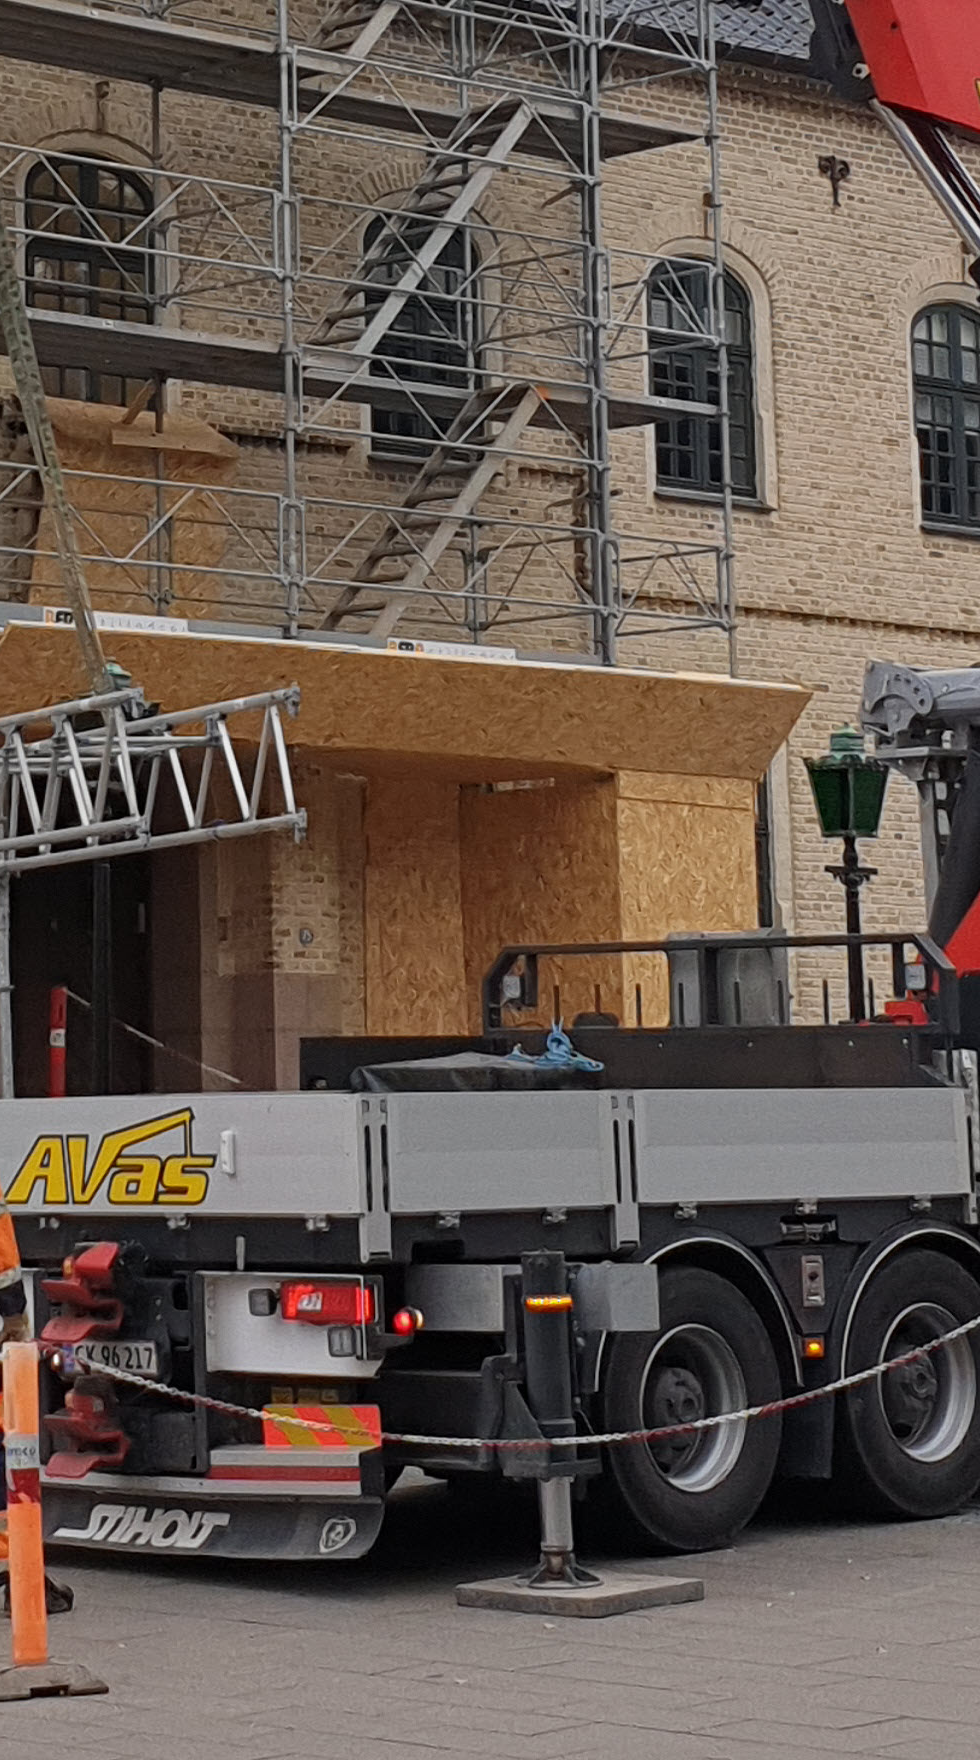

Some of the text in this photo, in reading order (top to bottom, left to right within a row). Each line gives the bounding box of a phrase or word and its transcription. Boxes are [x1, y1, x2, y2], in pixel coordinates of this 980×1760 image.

[101, 1345, 120, 1368] 96
[124, 1346, 152, 1369] 217
[53, 1503, 231, 1549] STIHOLT
